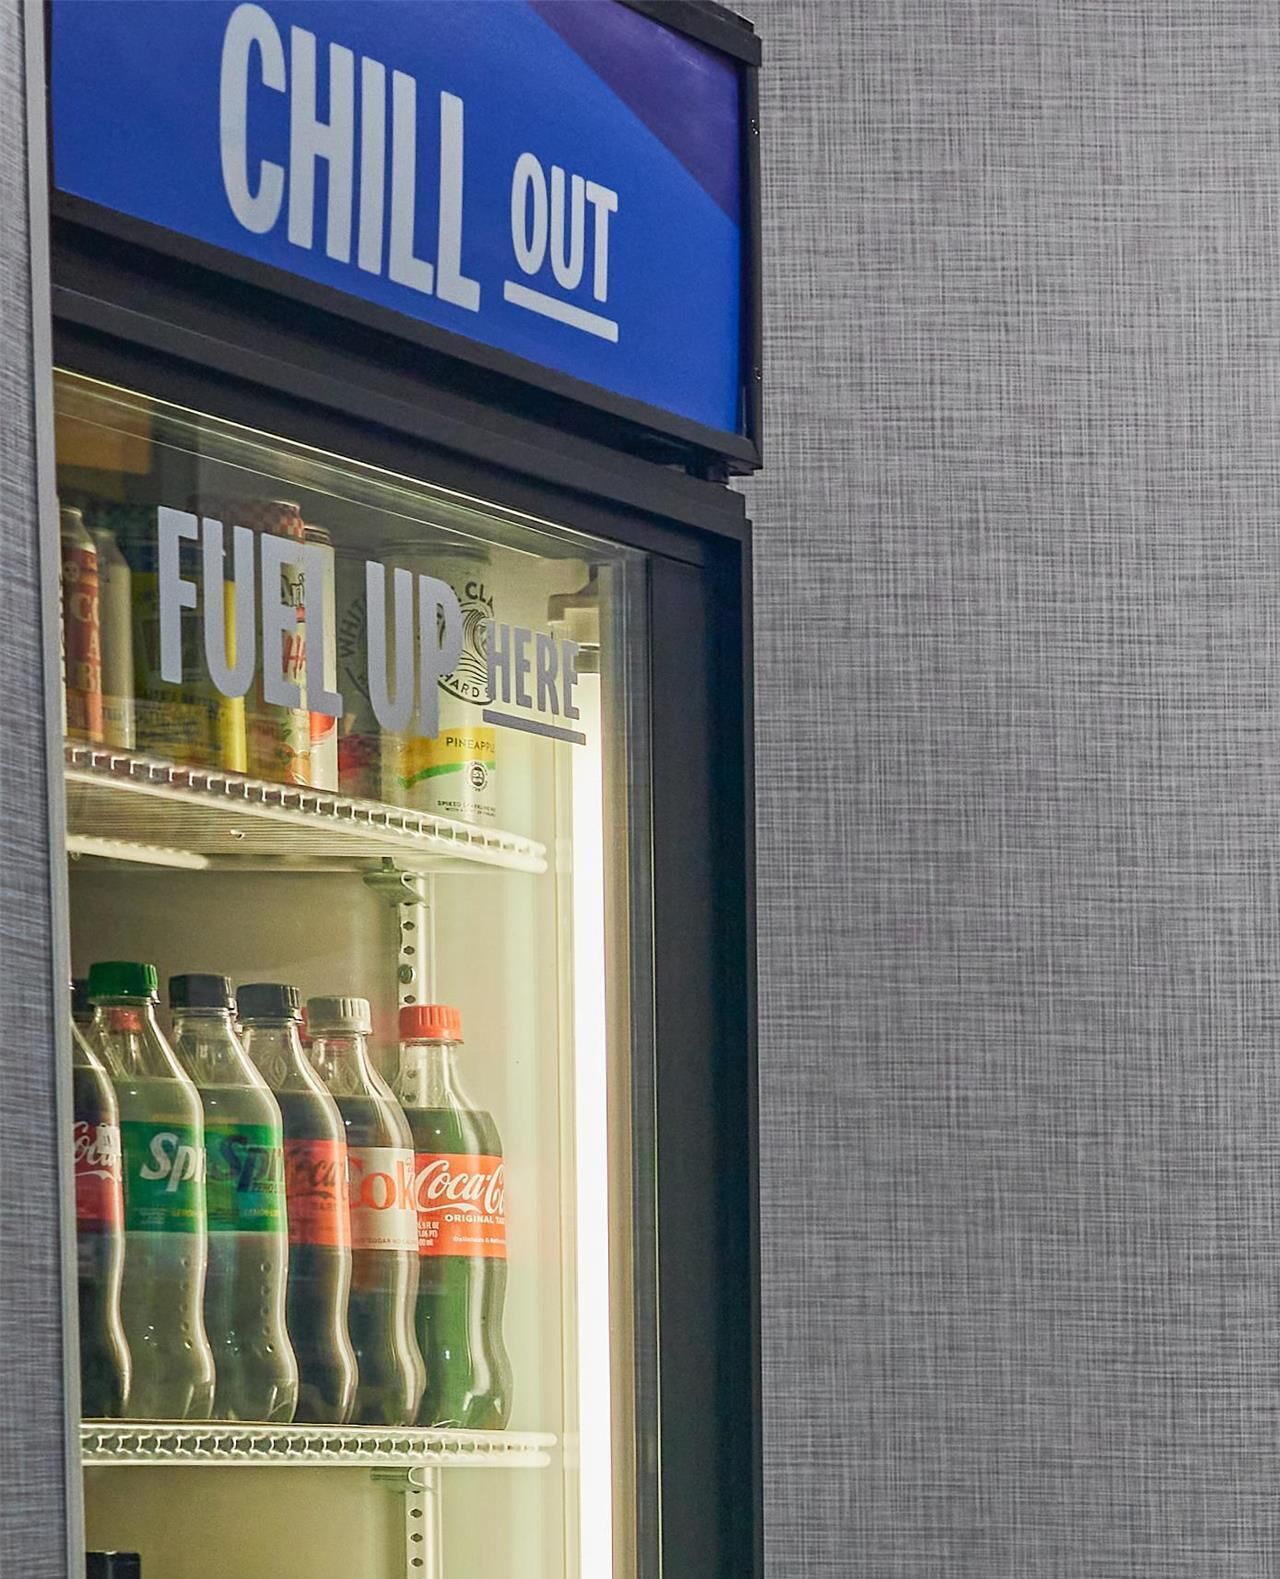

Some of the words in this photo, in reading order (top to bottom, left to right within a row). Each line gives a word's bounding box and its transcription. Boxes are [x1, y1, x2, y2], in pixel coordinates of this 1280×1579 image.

[220, 3, 480, 312] CHILL
[511, 152, 618, 303] OUT
[158, 505, 343, 718] FUEL
[366, 561, 463, 740] UP
[486, 619, 580, 720] HERE
[349, 1158, 415, 1211] Cok
[445, 1214, 494, 1224] ORIGINAL
